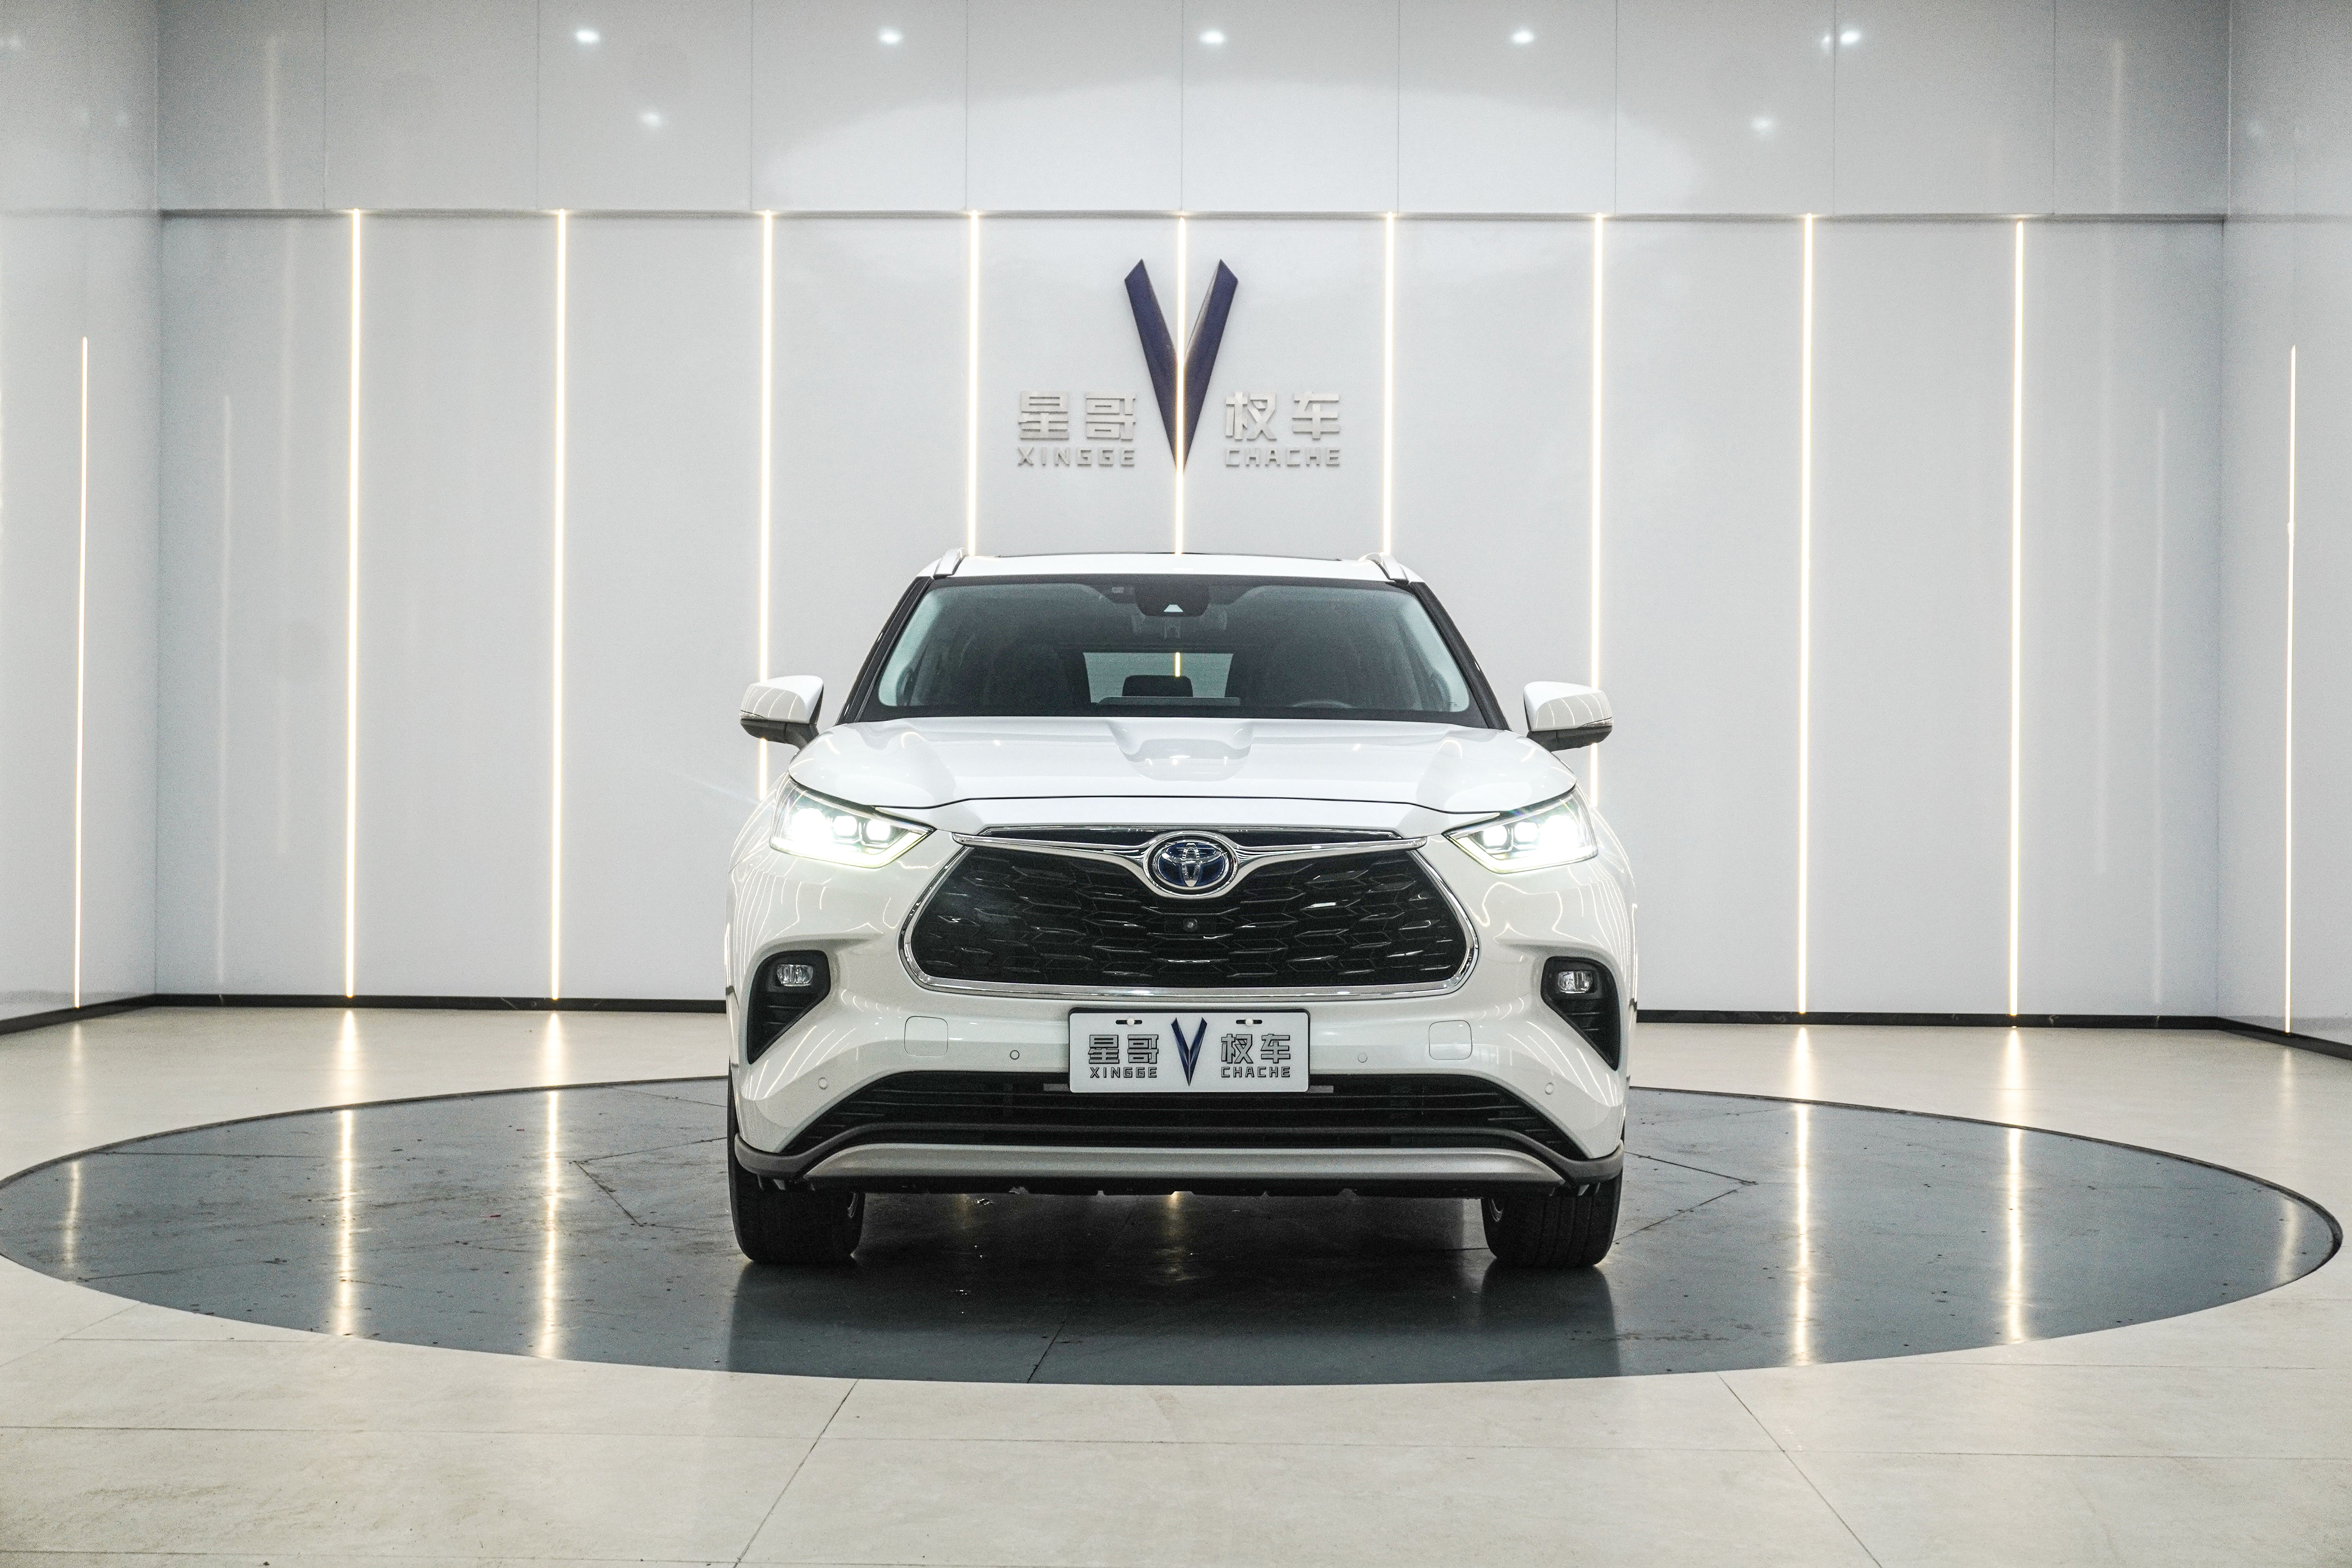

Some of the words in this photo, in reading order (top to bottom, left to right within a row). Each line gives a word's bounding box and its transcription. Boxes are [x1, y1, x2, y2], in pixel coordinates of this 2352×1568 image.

[1018, 391, 1136, 441] 星哥
[1018, 447, 1135, 467] XINGGE
[1226, 447, 1339, 467] CHACHE
[1088, 1034, 1159, 1064] 星哥
[1090, 1067, 1157, 1078] XINGGE
[1221, 1067, 1290, 1078] CHACHE
